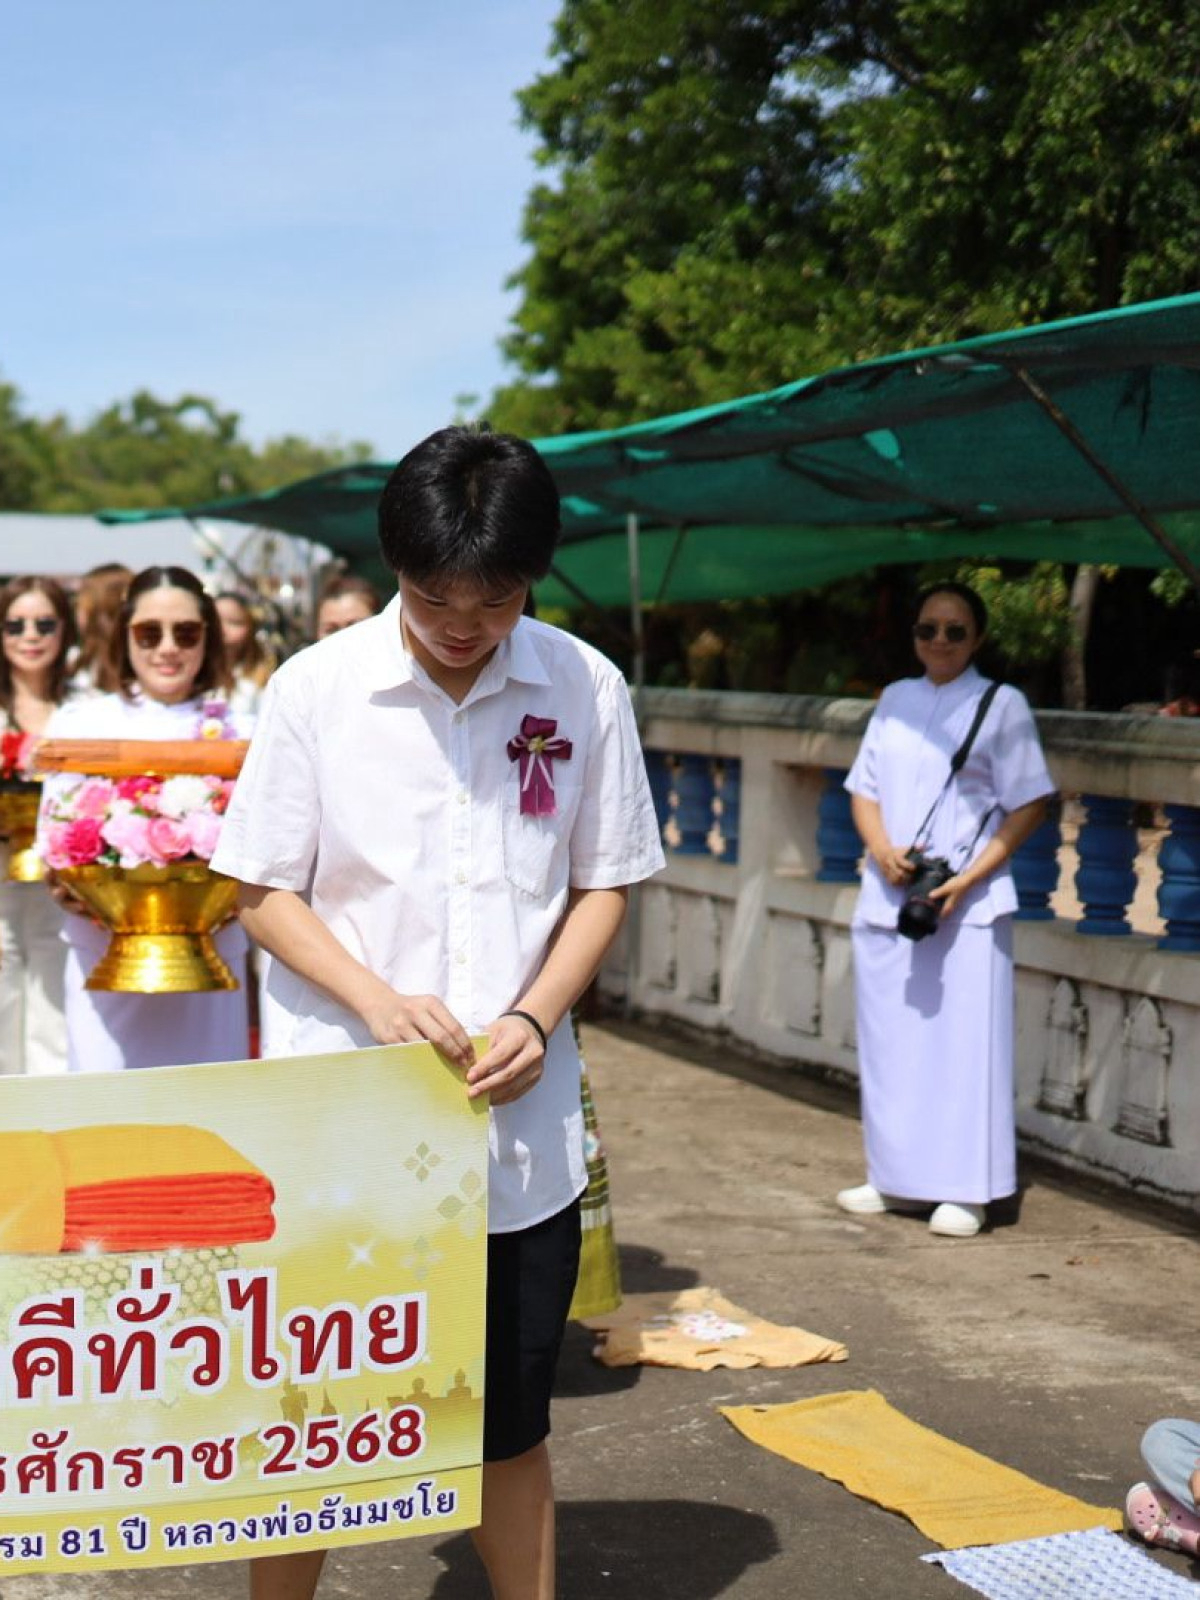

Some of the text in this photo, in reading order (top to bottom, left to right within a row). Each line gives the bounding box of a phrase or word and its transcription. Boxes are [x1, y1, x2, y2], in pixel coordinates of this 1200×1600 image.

[261, 1407, 425, 1475] 2568
[61, 1528, 105, 1555] 81
[120, 1516, 147, 1551] ปี
[164, 1482, 456, 1548] หลวงพ่อธัมมชโย
